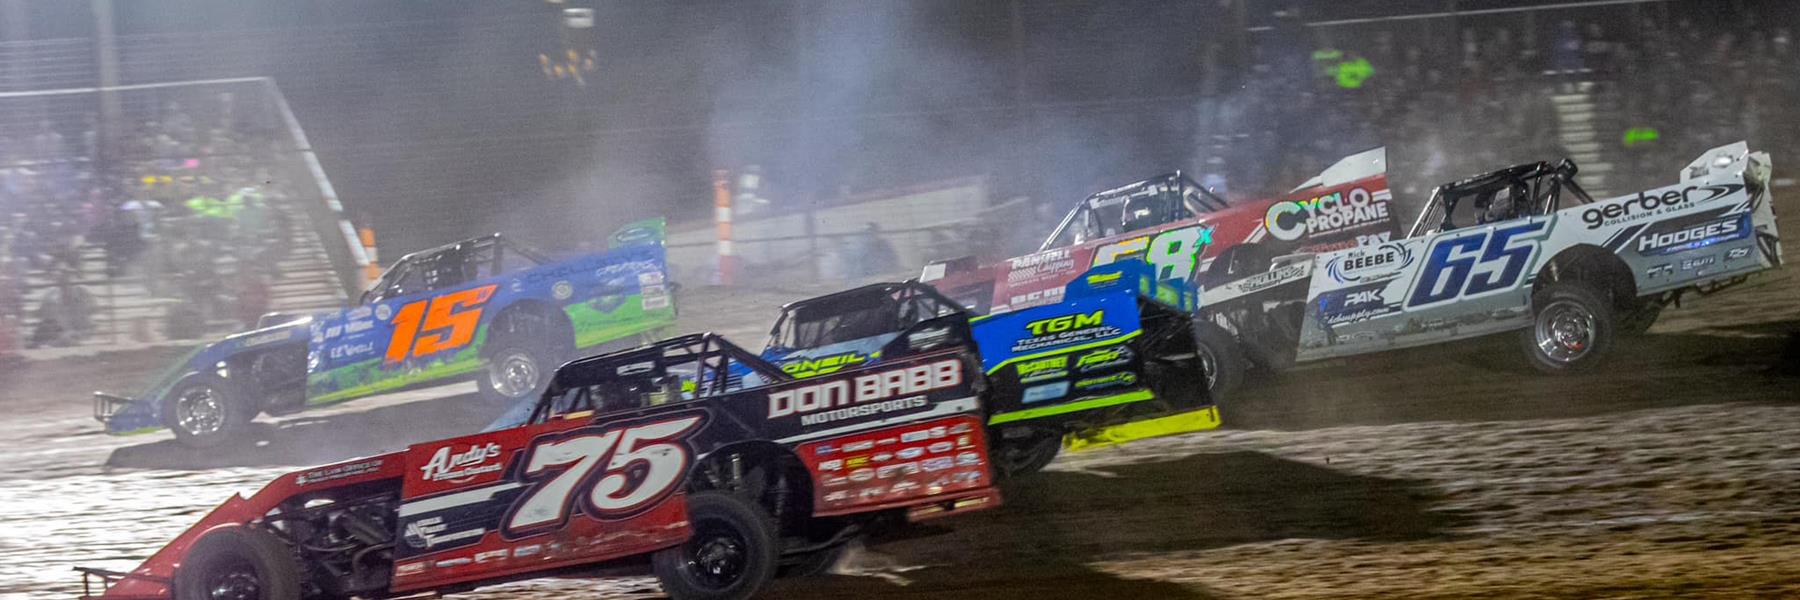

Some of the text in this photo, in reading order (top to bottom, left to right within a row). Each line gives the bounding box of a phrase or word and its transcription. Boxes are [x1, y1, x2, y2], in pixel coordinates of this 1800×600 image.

[1265, 188, 1371, 241] CYCLO
[1306, 202, 1389, 234] PROPANE
[1582, 186, 1699, 230] gerber
[1604, 210, 1653, 226] COLLISION
[1665, 202, 1695, 213] GLASS
[1638, 218, 1739, 252] HODGES
[1344, 251, 1395, 271] BEEBE
[1407, 221, 1547, 307] 65
[386, 285, 498, 363] 15
[1017, 325, 1114, 346] TEXAS GENERAL
[1026, 310, 1104, 336] TGM
[1095, 328, 1121, 340] LLC
[768, 359, 962, 419] DON BABB
[801, 395, 928, 426] MOTORSPORTS
[420, 443, 501, 480] Andy's
[505, 414, 703, 533] 75
